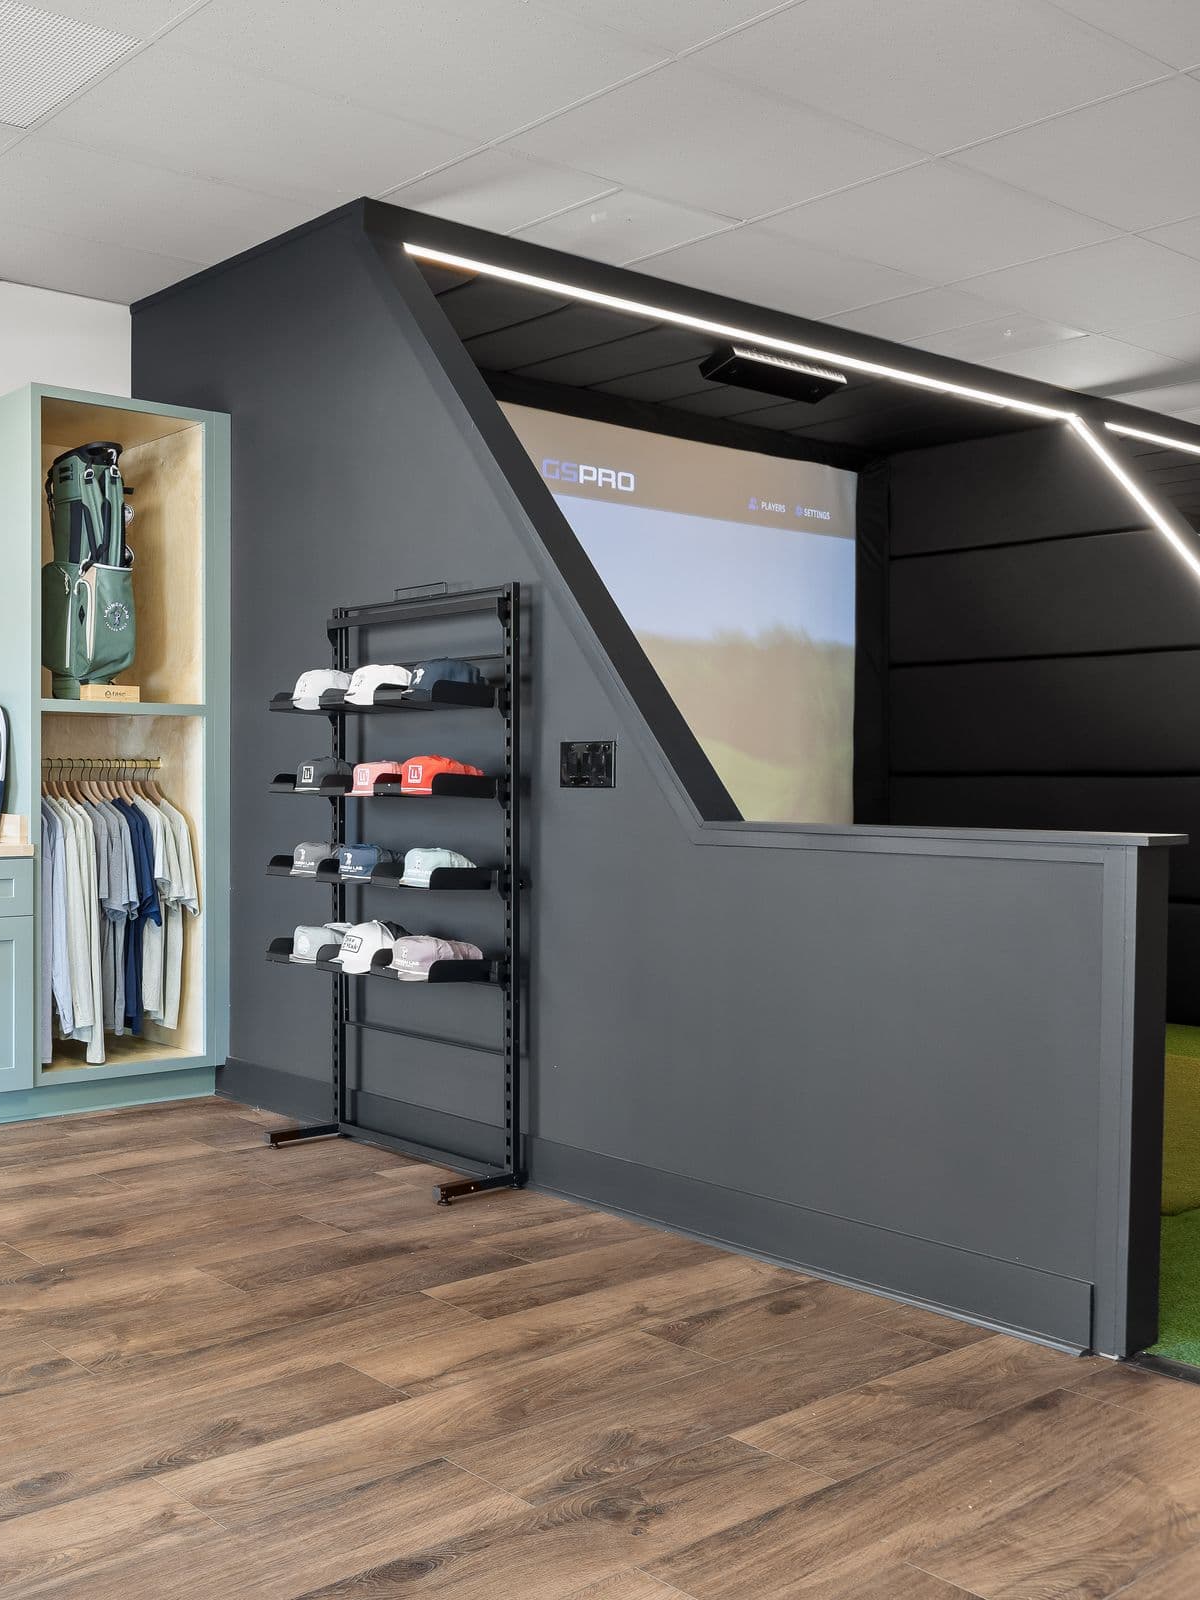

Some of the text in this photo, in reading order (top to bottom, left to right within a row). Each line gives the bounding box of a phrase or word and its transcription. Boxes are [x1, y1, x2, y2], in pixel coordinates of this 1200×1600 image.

[542, 459, 635, 492] GSPRO
[761, 501, 786, 513] PLAYERS
[803, 508, 831, 520] SETTINGS
